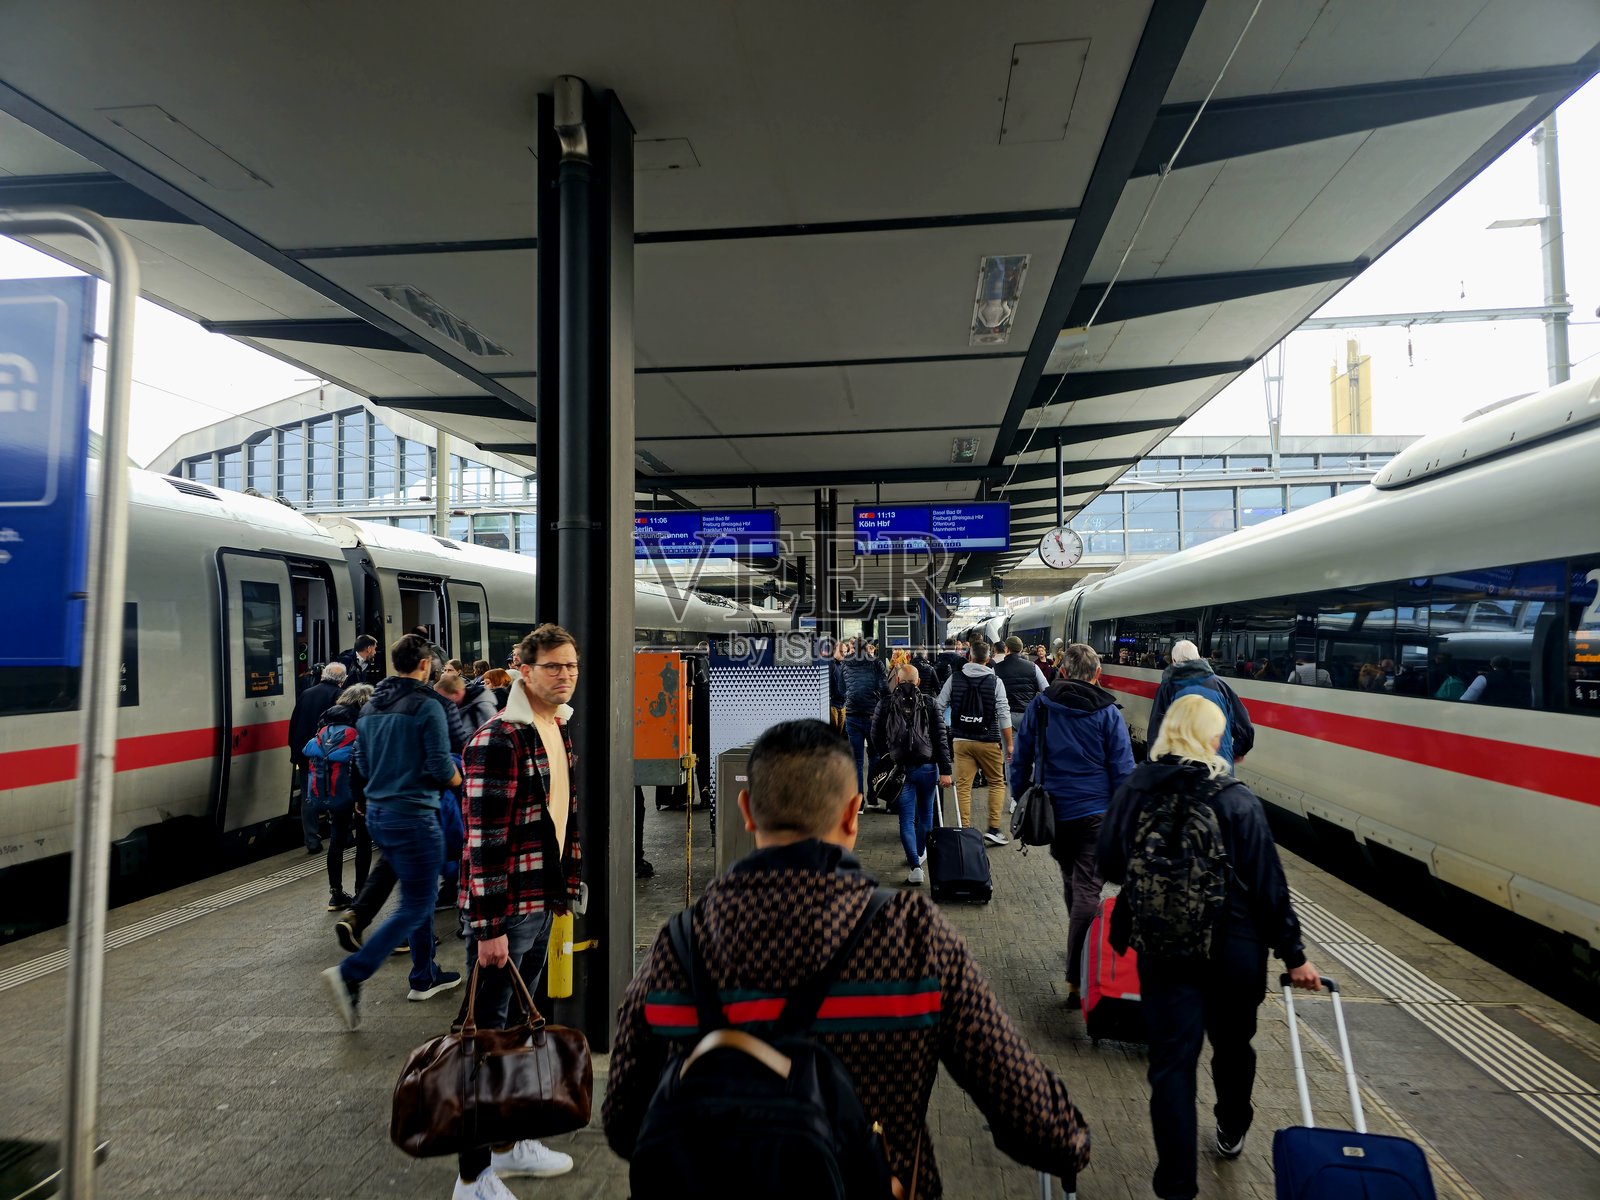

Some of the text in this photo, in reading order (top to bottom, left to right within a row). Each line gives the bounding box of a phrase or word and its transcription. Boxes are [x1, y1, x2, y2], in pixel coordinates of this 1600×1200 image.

[877, 511, 896, 519] 11:13
[858, 519, 891, 528] Köln Hbf
[949, 596, 958, 604] 12
[960, 714, 983, 723] CCM
